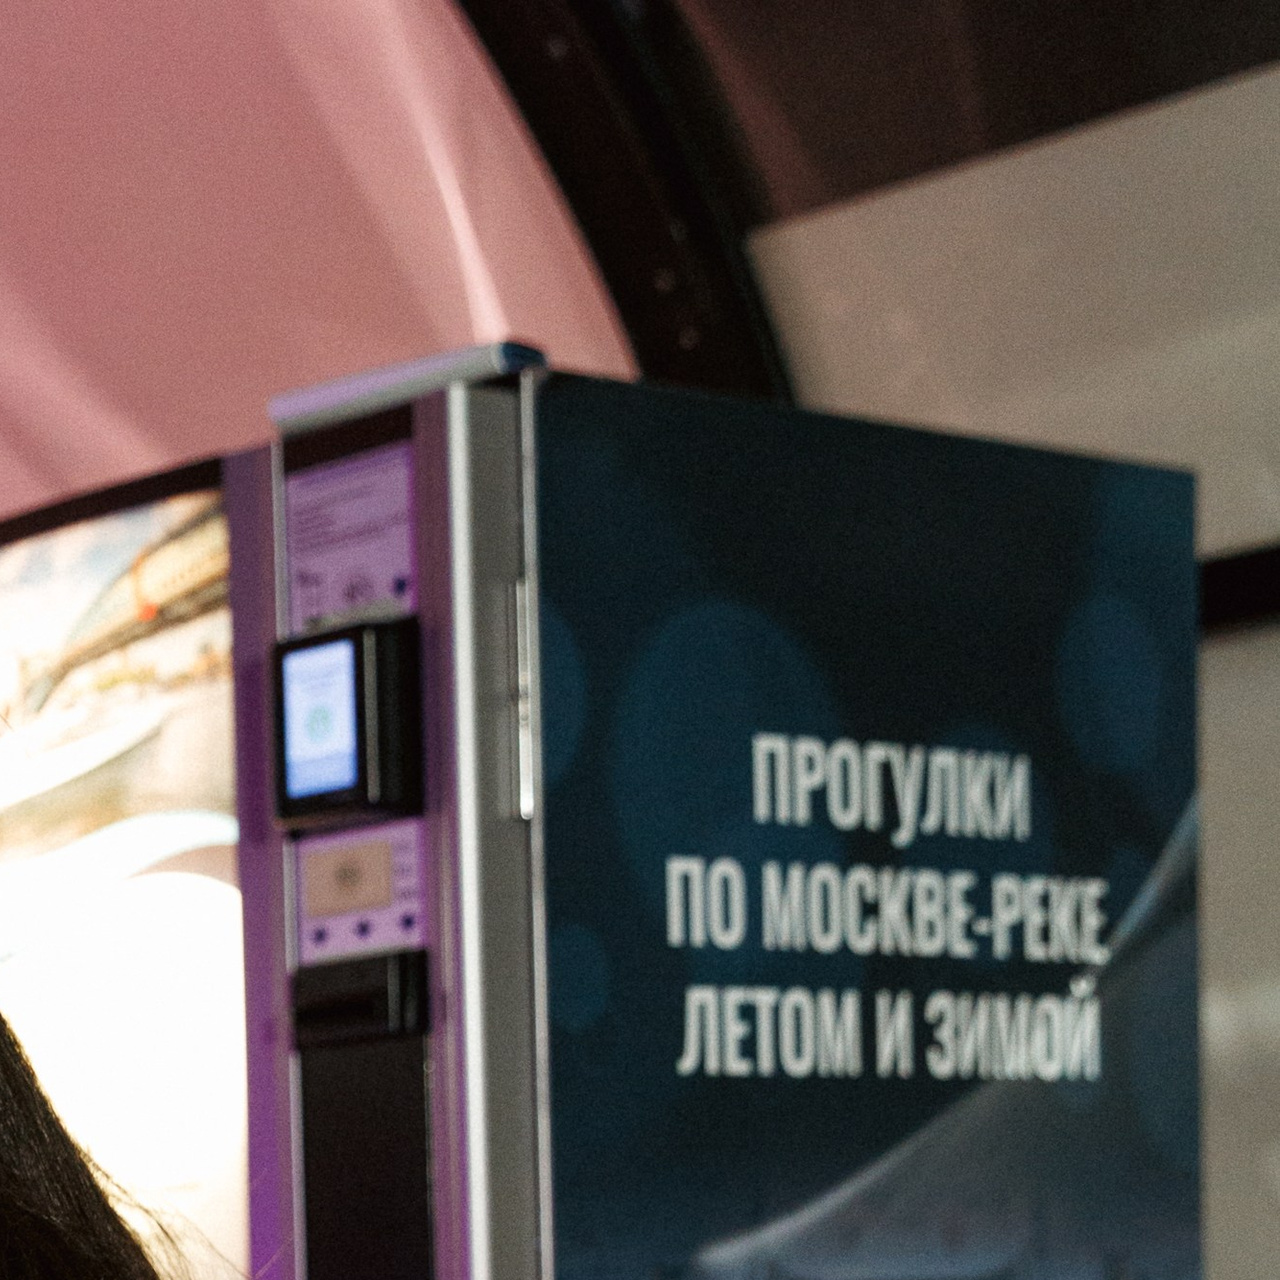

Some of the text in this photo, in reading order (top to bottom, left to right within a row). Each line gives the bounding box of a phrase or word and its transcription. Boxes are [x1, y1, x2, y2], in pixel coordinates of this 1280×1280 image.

[752, 733, 1031, 847] ПРОГУЛКИ
[665, 855, 1111, 965] ПО МОСКВЕ-РЕКЕ
[676, 973, 1103, 1083] ЛЕТОМ И ЗИМОЙ
